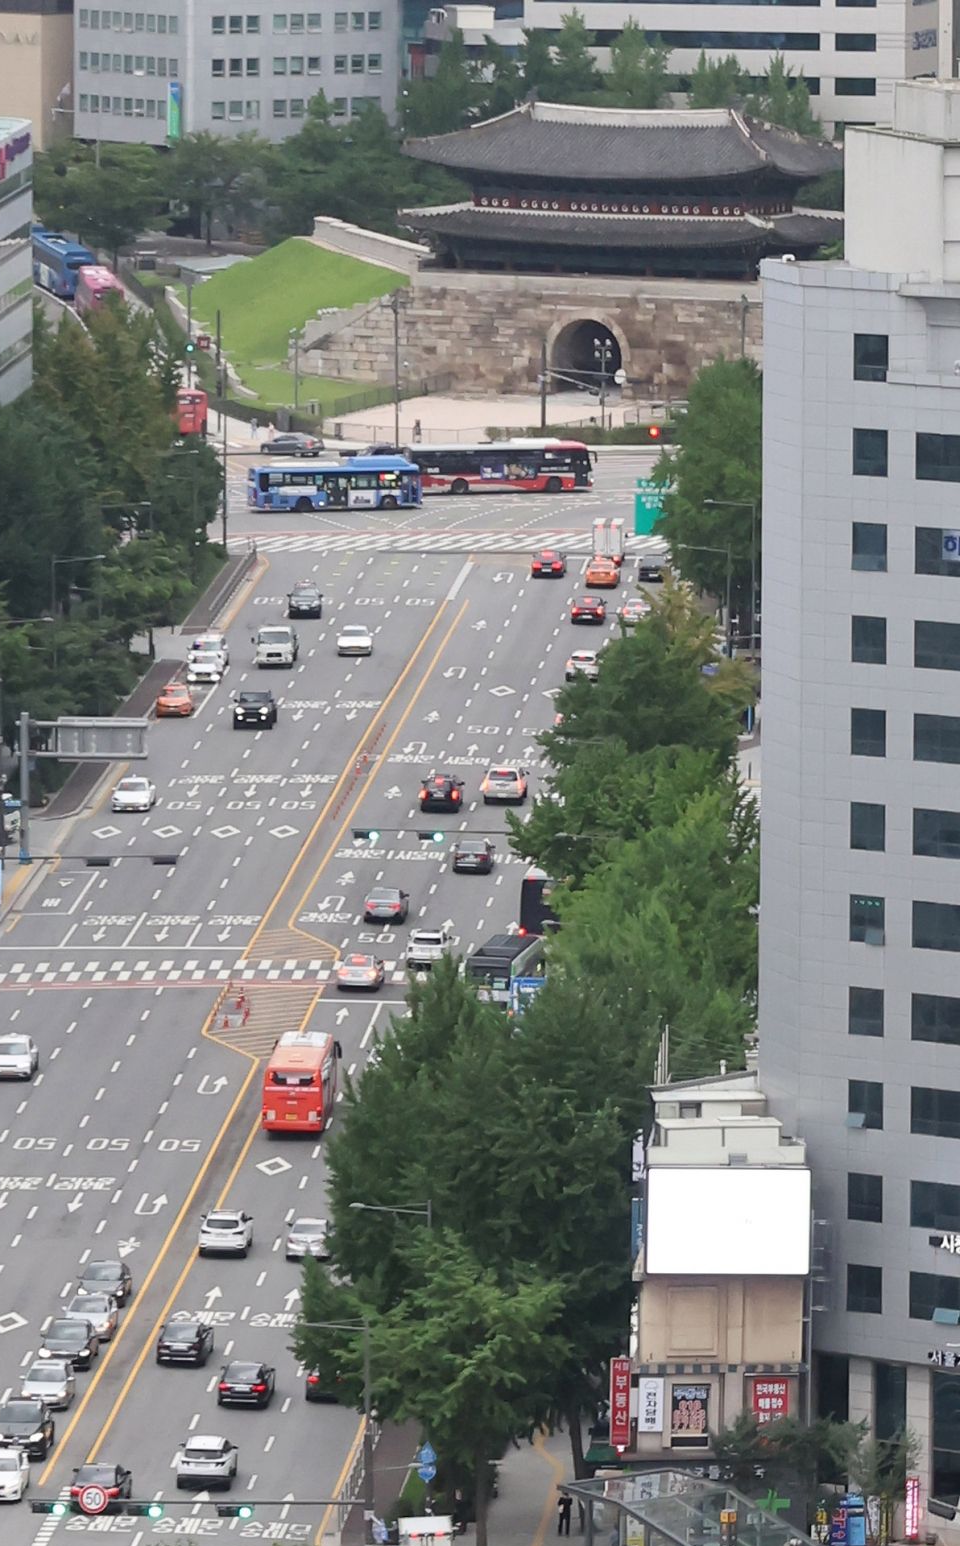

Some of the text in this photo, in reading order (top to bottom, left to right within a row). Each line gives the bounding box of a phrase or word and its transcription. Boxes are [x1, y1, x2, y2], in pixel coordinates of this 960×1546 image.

[466, 725, 500, 735] 50
[166, 800, 202, 810] 50
[226, 800, 262, 810] 50
[281, 800, 317, 810] 50
[357, 932, 396, 944] 50
[12, 1137, 58, 1150] 50
[86, 1137, 131, 1151] 50
[157, 1138, 202, 1152] 50
[53, 1176, 116, 1191] 광화문
[930, 1349, 960, 1368] 서울
[615, 1375, 628, 1426] 부동산
[644, 1391, 657, 1424] 전자담배
[85, 1492, 102, 1505] 50
[64, 1515, 139, 1533] 숭례문
[151, 1516, 225, 1536] 숭례문
[240, 1520, 312, 1541] 숭례문
